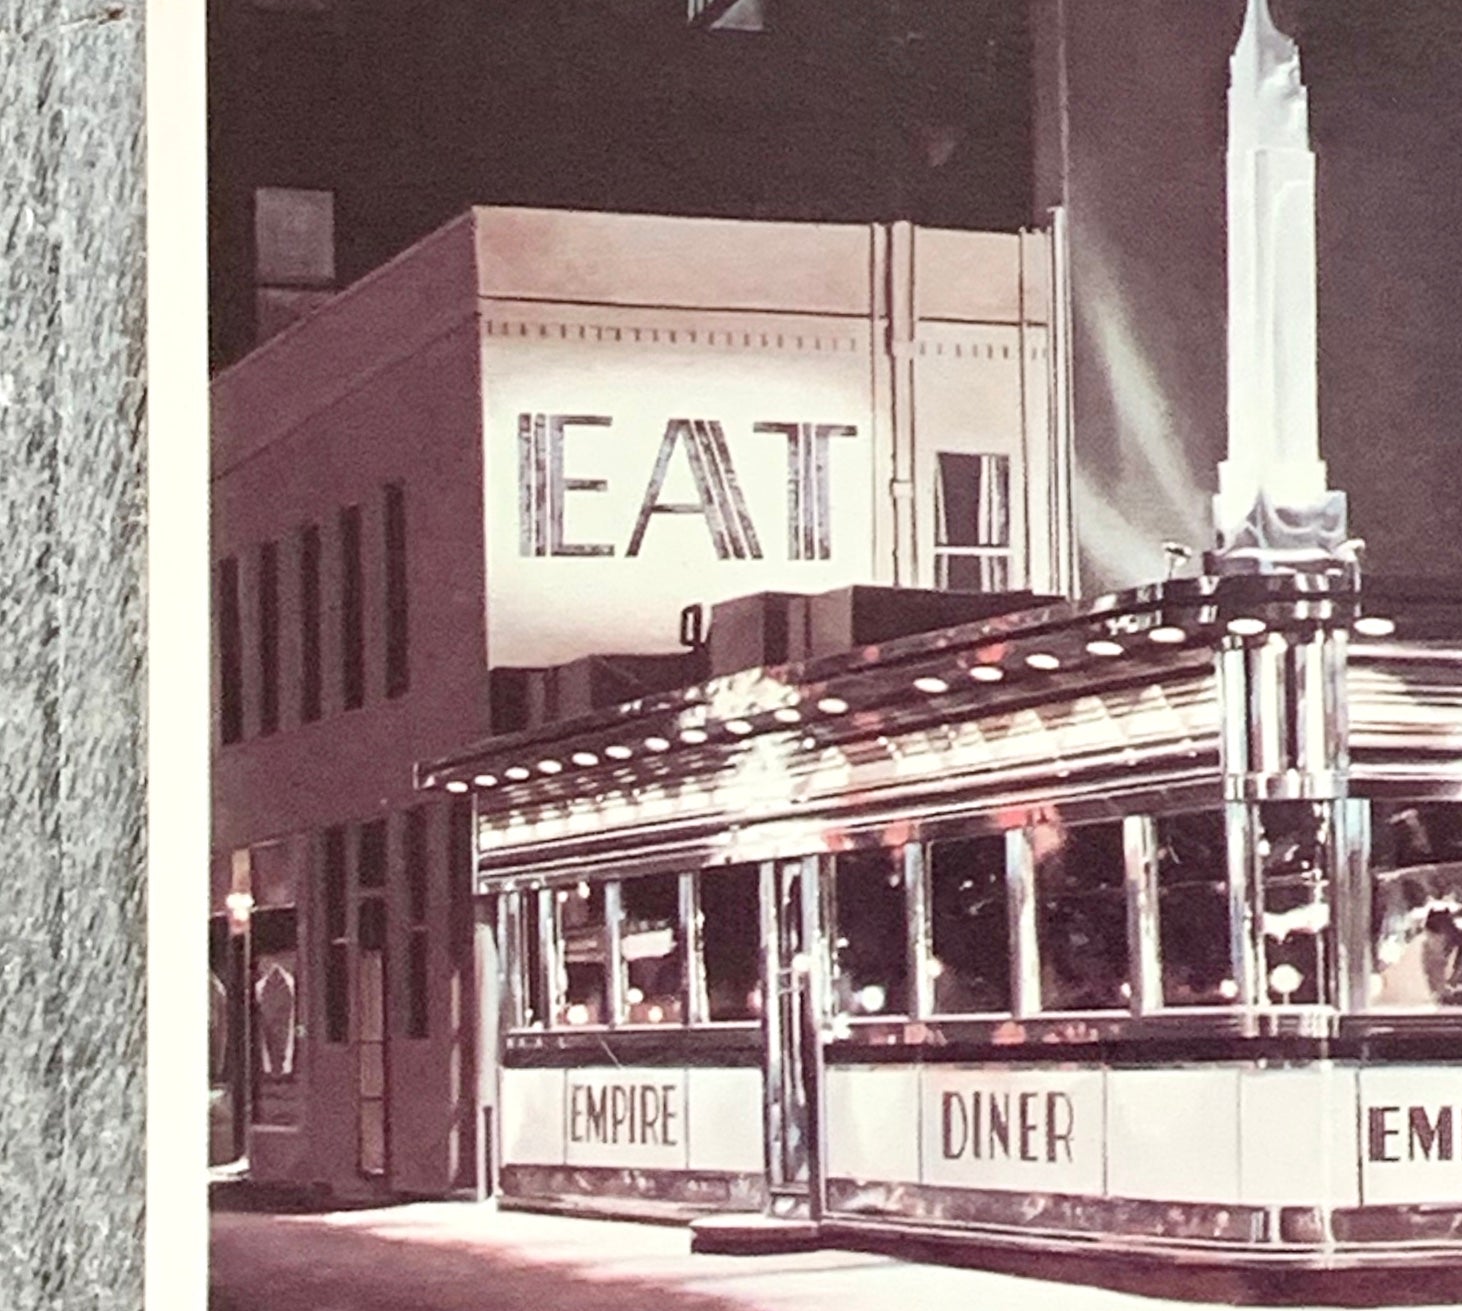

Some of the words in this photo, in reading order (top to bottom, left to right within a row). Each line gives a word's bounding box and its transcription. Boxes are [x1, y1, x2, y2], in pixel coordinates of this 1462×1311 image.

[518, 413, 857, 560] EAT
[571, 1084, 677, 1146] EMPIRE
[942, 1091, 1074, 1163] DINER
